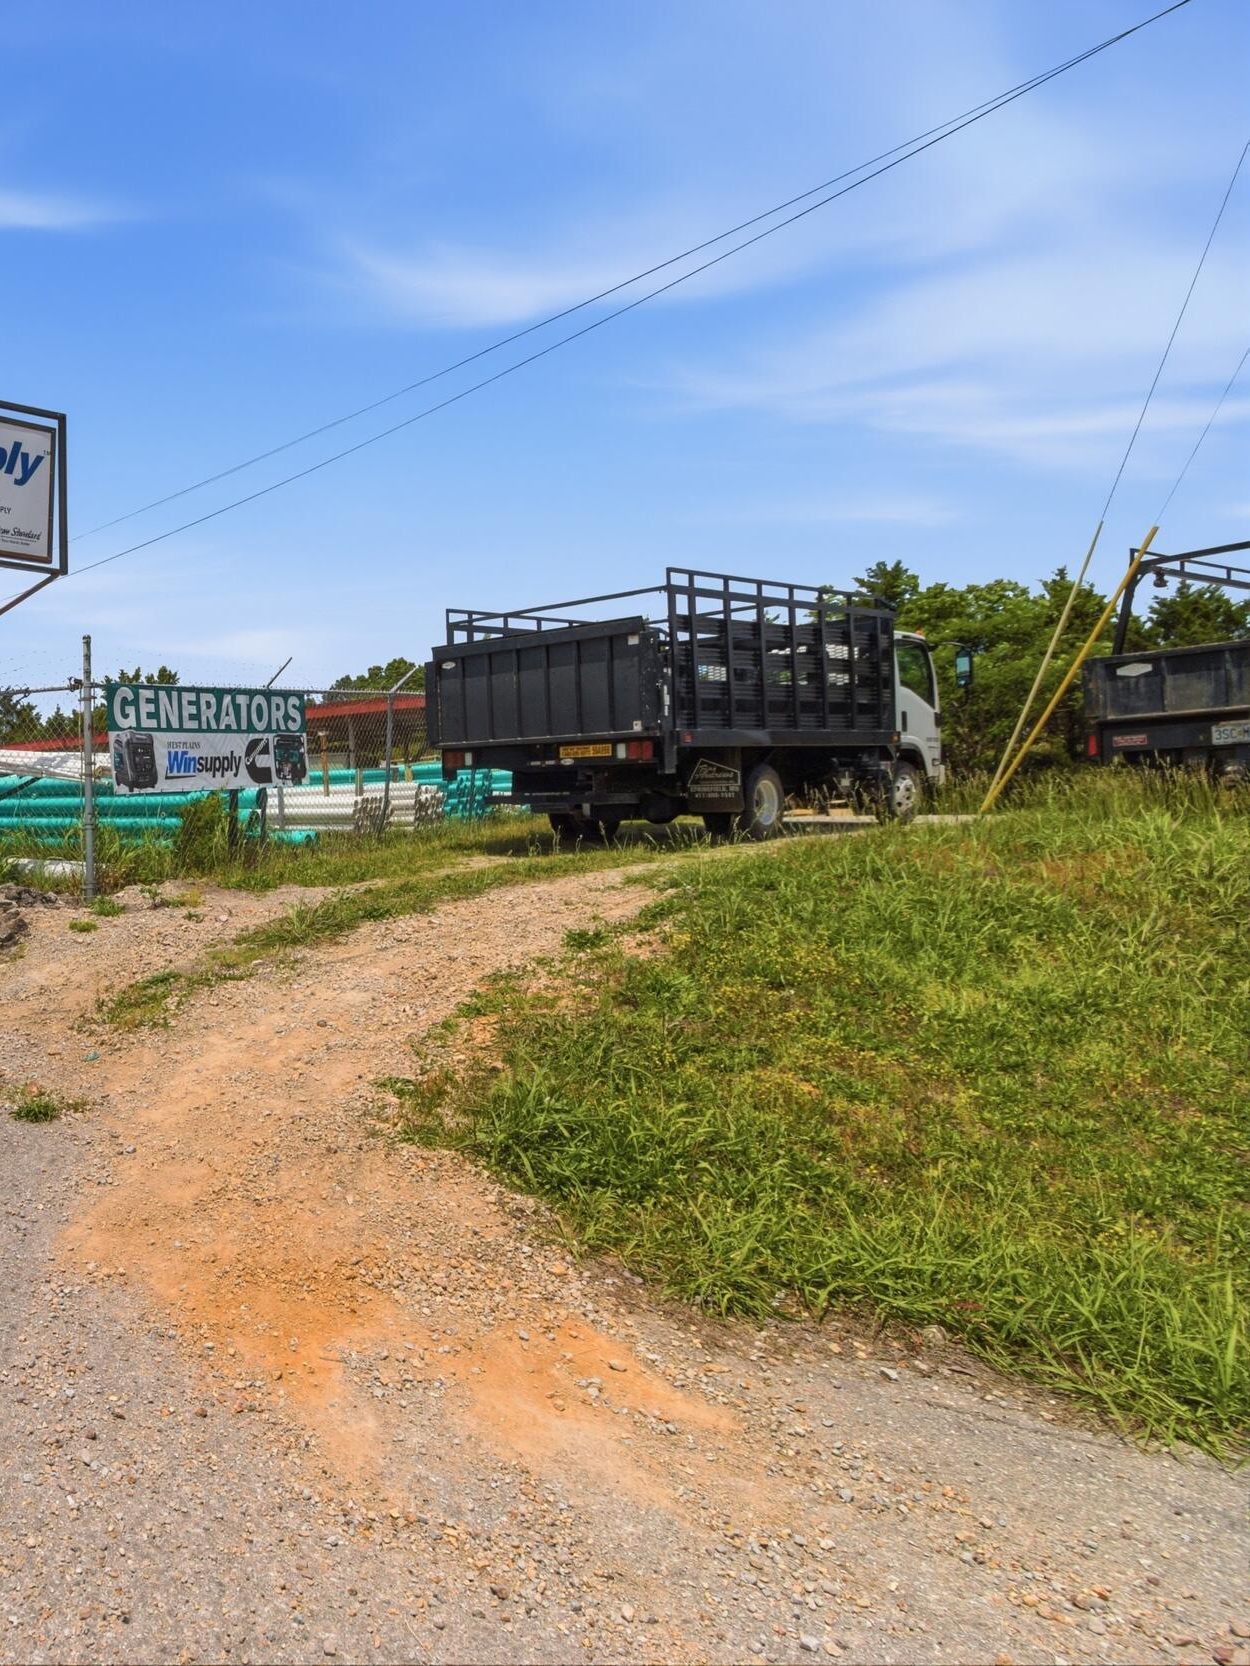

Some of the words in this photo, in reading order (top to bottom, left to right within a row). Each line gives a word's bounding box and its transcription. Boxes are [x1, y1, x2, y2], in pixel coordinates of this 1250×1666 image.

[113, 686, 302, 732] GENERATORS
[167, 741, 182, 750] WEST
[182, 741, 201, 750] PLAINS
[167, 750, 242, 778] Winsupply
